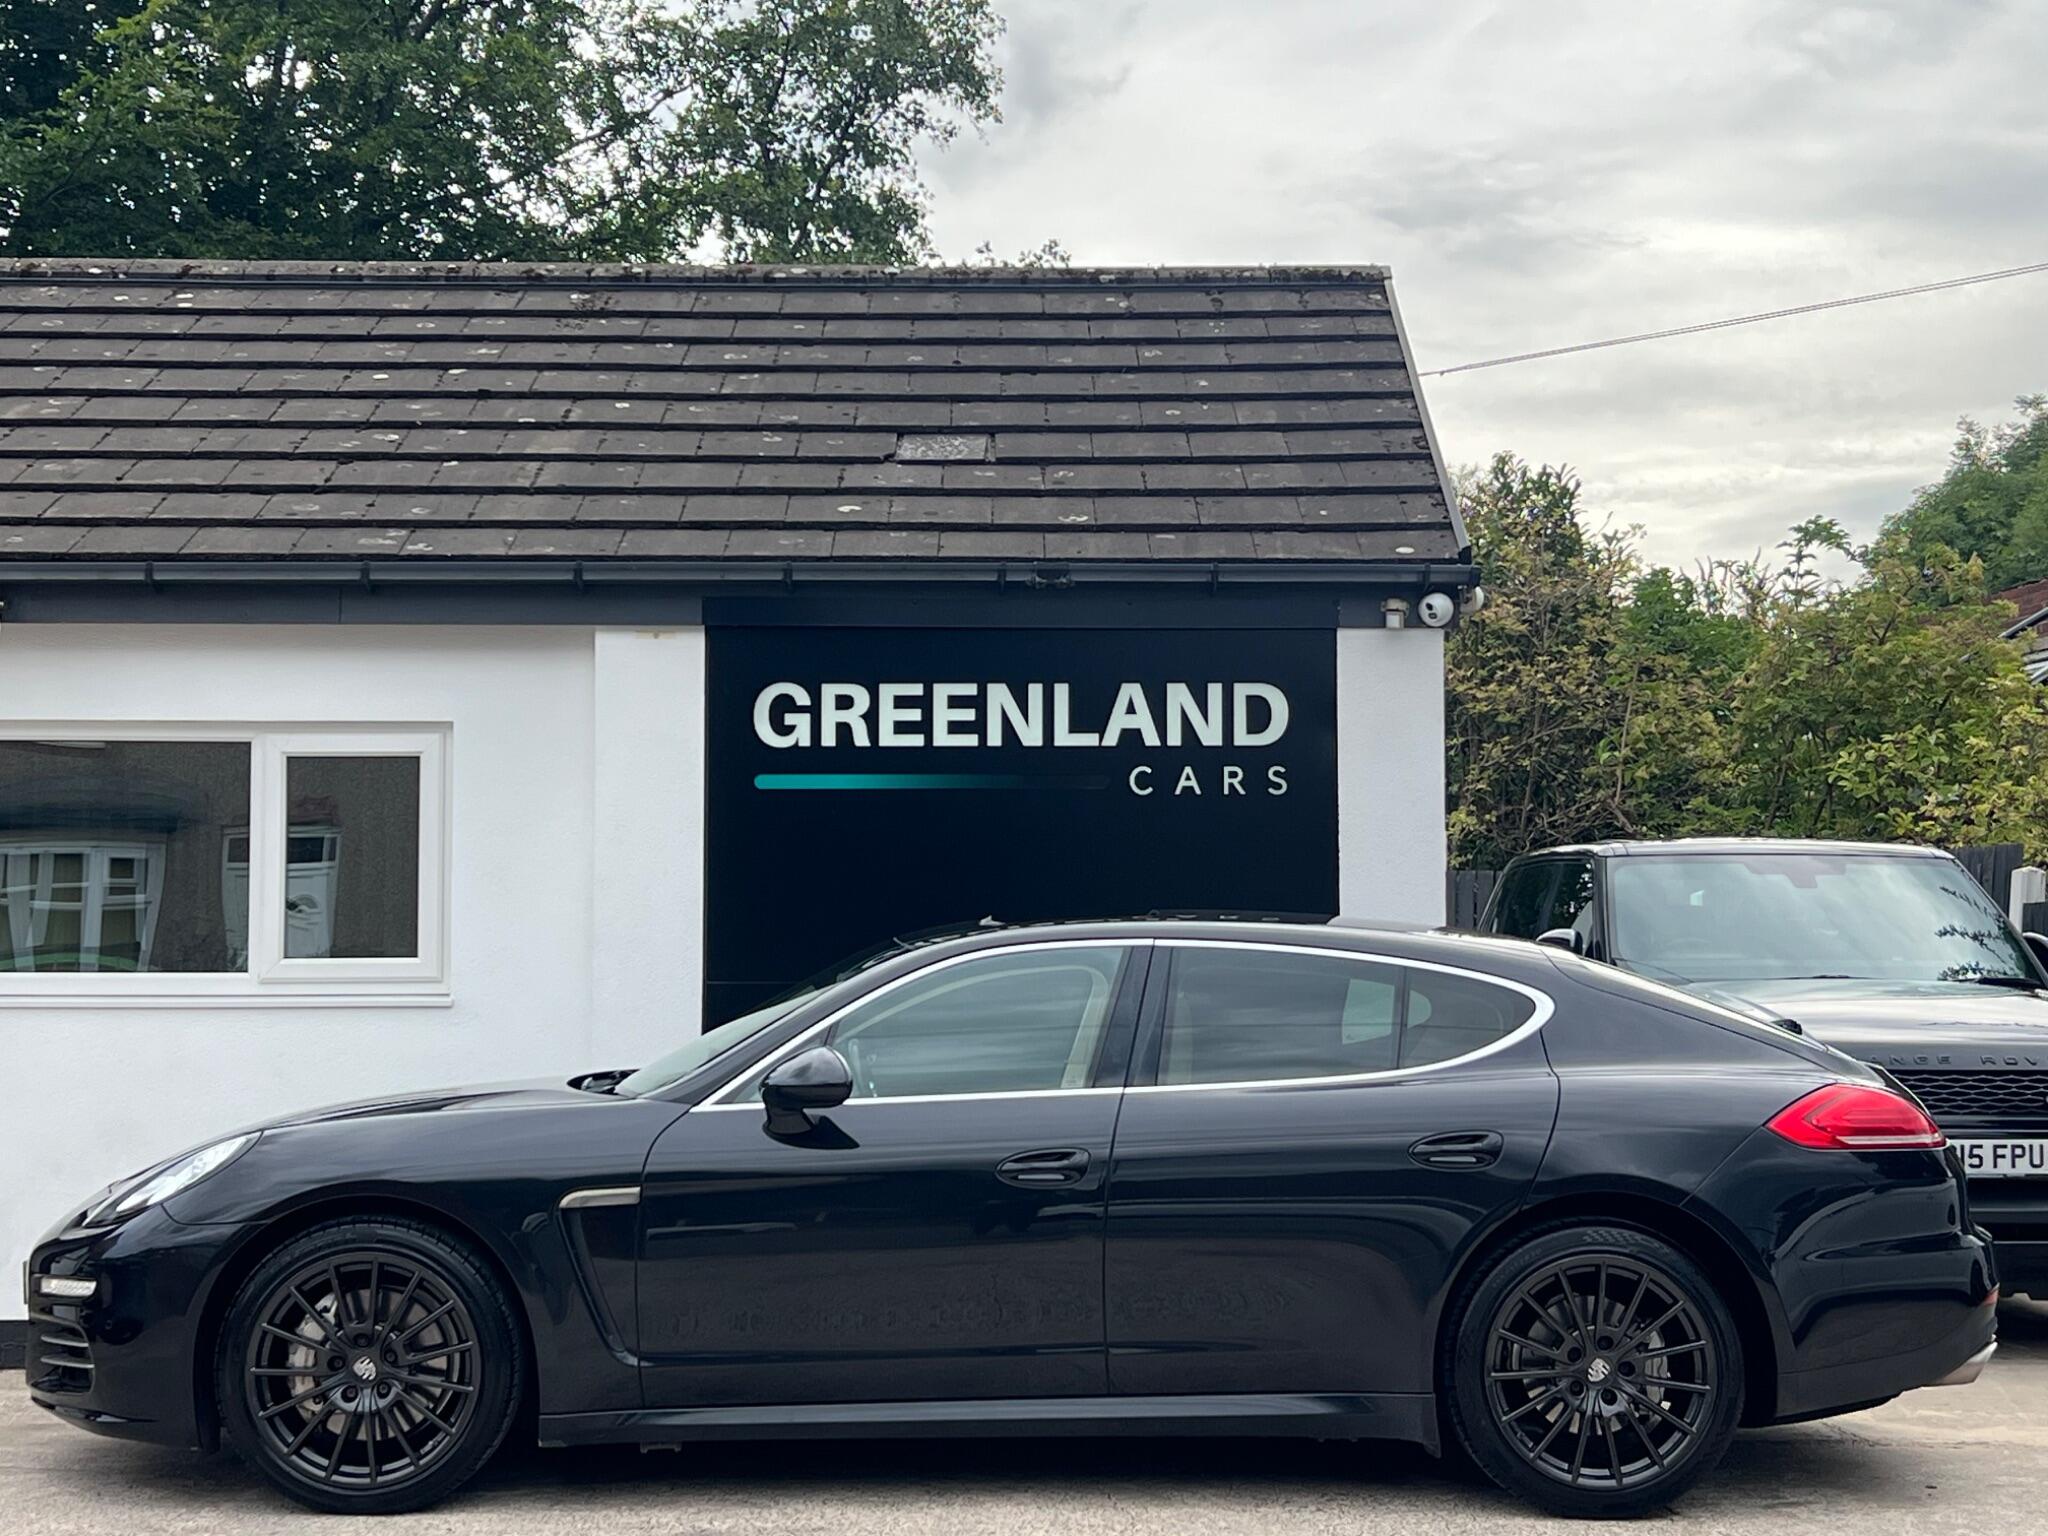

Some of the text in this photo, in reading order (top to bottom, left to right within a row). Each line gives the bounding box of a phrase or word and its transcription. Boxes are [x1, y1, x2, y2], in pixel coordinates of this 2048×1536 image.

[753, 682, 1290, 748] GREENLAND
[1129, 766, 1288, 796] CARS
[1979, 1055, 2048, 1067] ROV
[1951, 1144, 2044, 1169] 15 FPU
